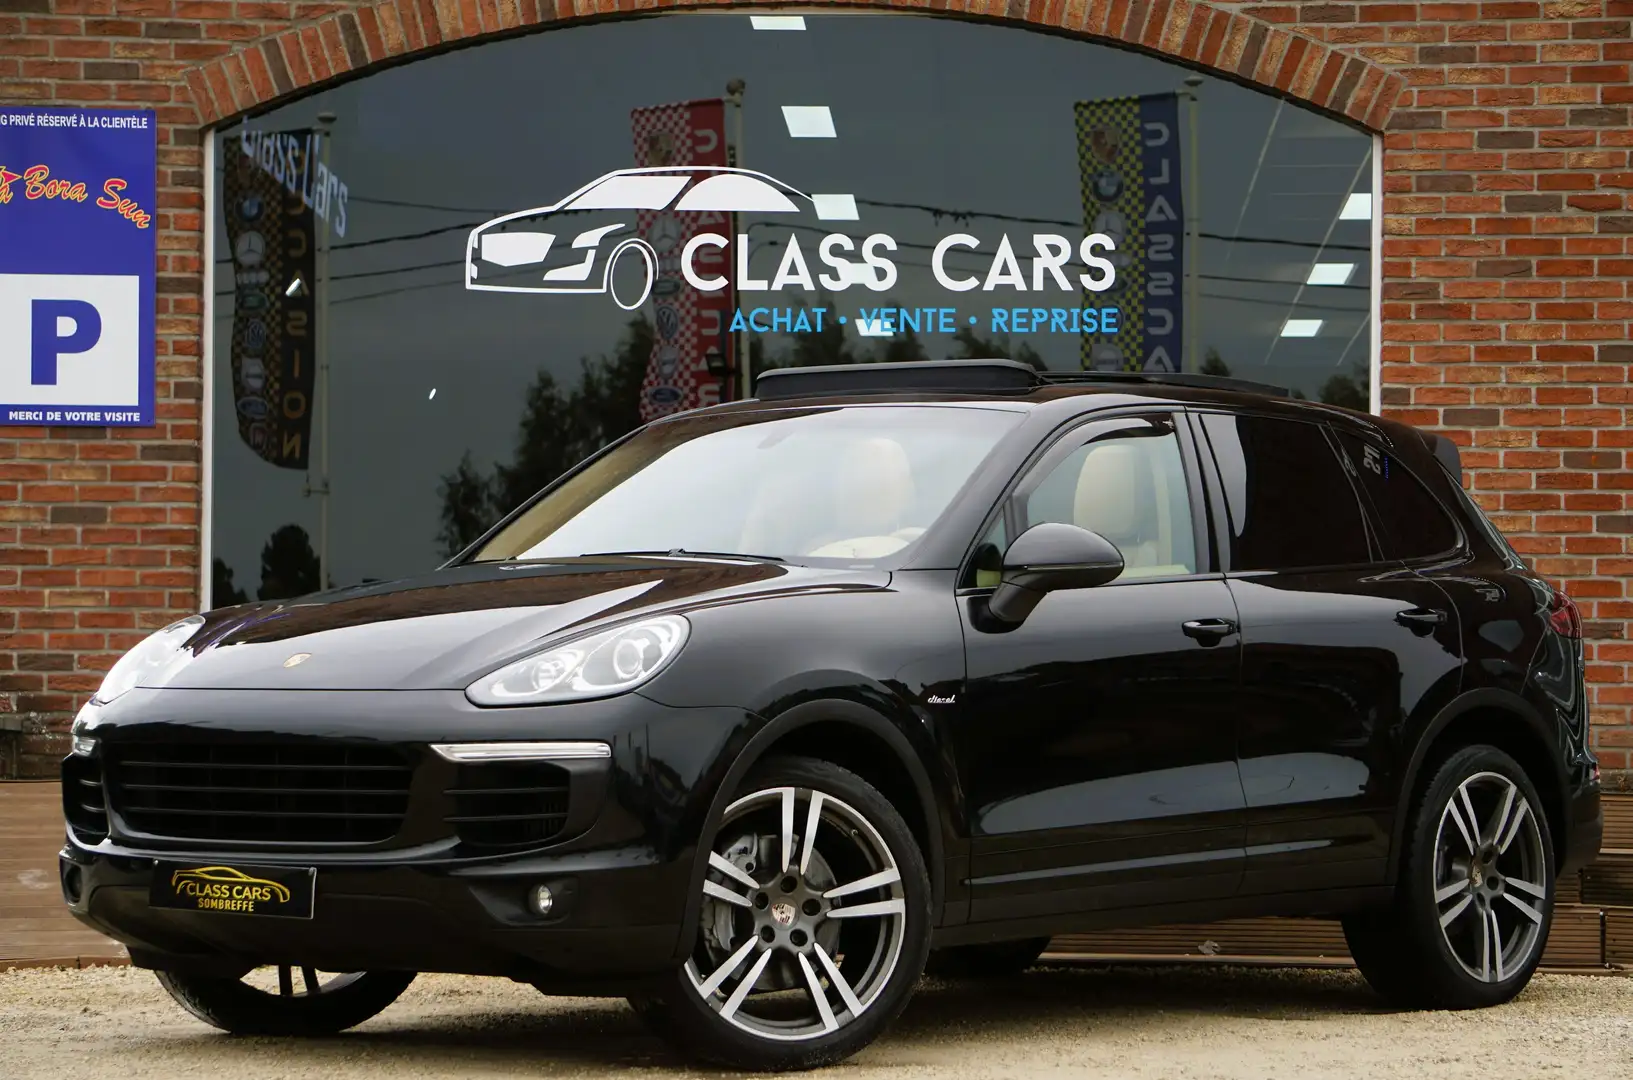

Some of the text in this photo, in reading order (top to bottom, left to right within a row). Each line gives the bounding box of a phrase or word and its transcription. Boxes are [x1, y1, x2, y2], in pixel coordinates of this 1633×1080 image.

[9, 113, 35, 126] PRIVÉ
[37, 114, 77, 127] RÉSERVÉ
[79, 114, 86, 128] À
[88, 116, 100, 128] LA
[101, 115, 148, 129] CLIENTÈLE
[24, 164, 88, 203] Bora
[96, 178, 151, 229] Sun
[680, 232, 1117, 292] CLASS CARS
[729, 307, 1119, 333] ACHAT VENTE REPRISE
[31, 299, 102, 385] P
[8, 411, 140, 422] MERCI DE VOTRE VISITE
[186, 882, 271, 901] CLASS CARS
[198, 897, 255, 912] SOMBREFFE
